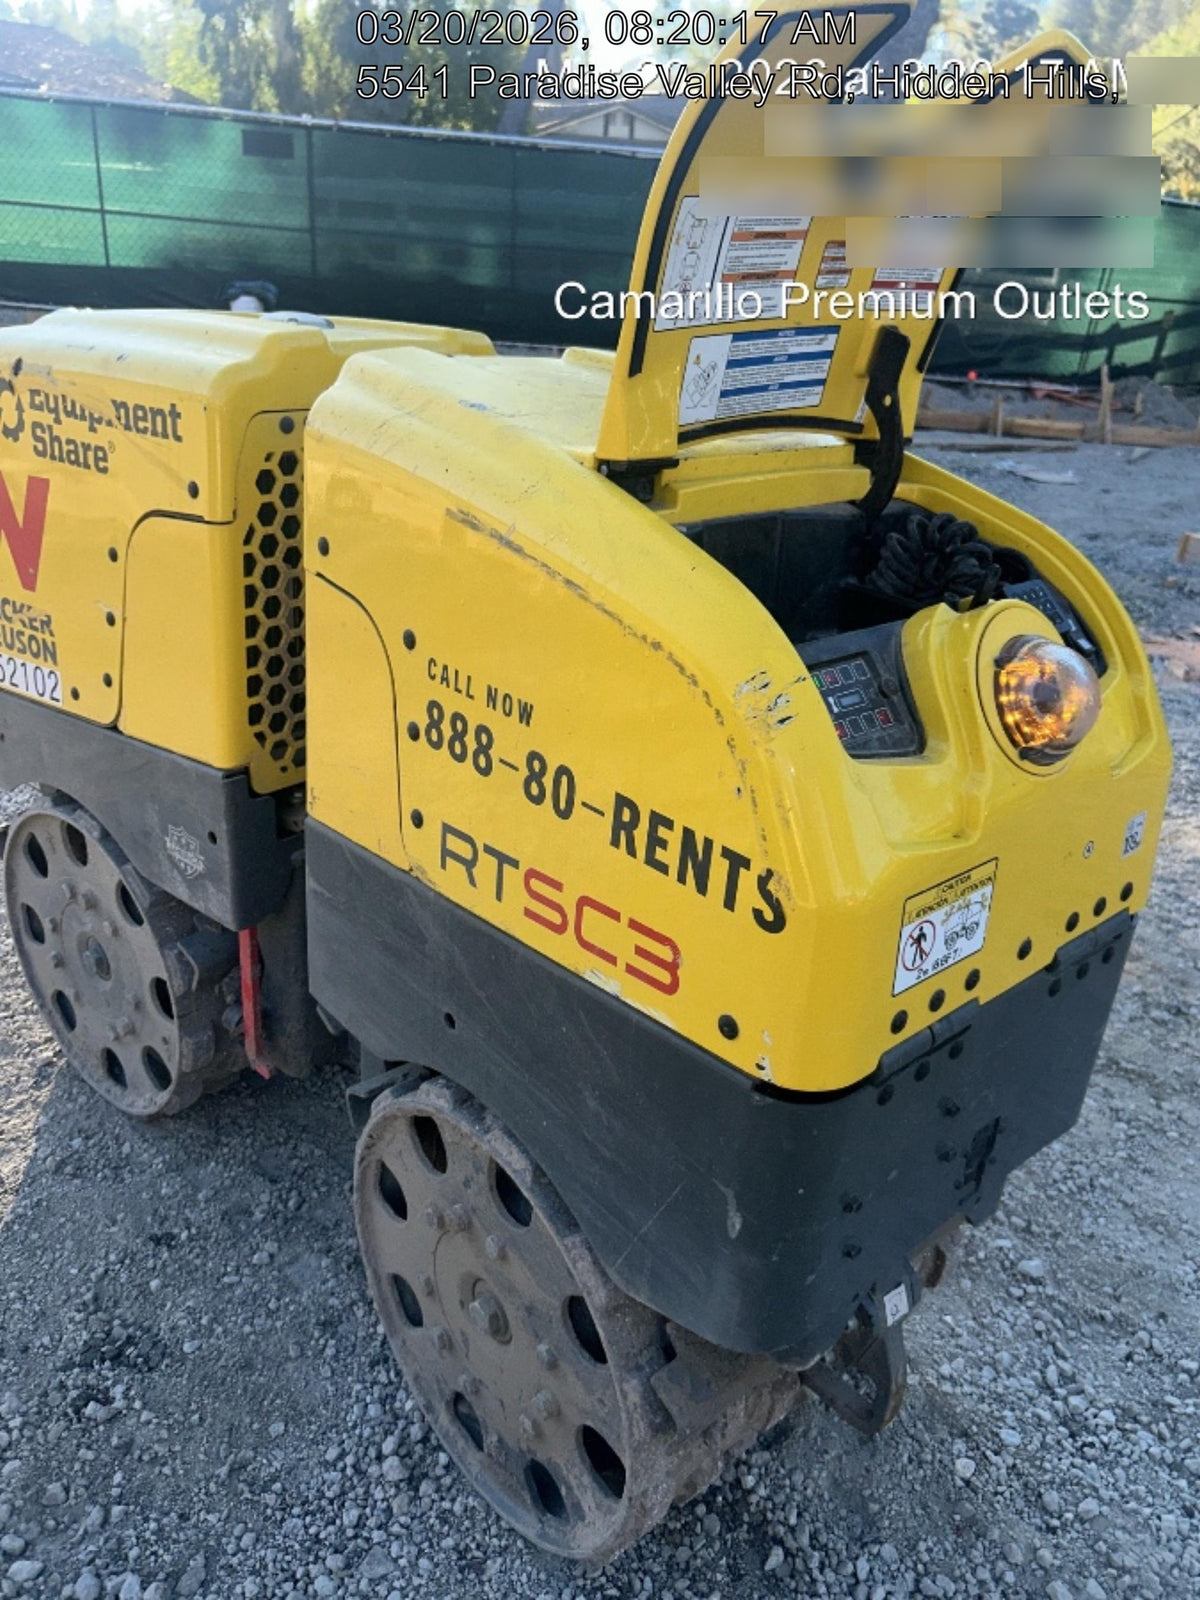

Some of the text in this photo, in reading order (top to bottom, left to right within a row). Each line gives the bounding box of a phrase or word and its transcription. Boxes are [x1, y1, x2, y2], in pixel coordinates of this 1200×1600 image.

[0, 597, 55, 637] CKER
[0, 624, 58, 667] USON
[427, 658, 535, 728] CALL NOW
[424, 699, 787, 934] 888-80-RENTS
[440, 821, 682, 996] RTSC3
